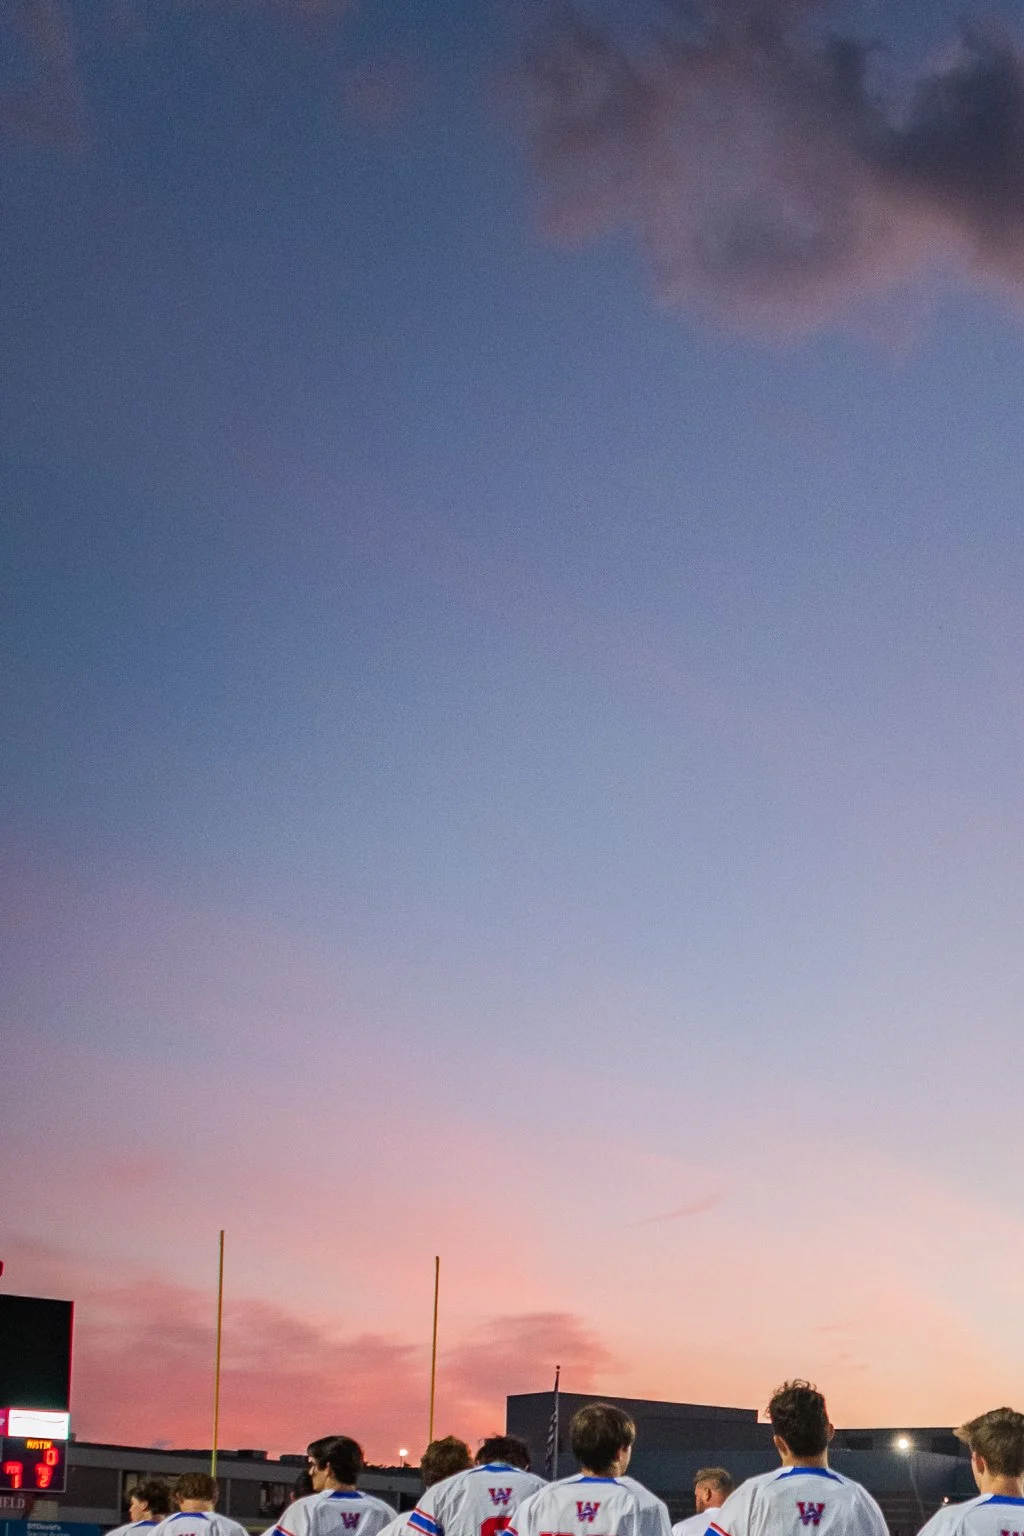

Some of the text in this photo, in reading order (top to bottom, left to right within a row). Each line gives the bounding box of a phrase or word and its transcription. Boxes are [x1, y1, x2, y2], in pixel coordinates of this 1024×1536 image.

[26, 1440, 53, 1450] AUSTIN
[46, 1449, 58, 1466] 0
[488, 1488, 513, 1505] W
[576, 1501, 601, 1523] W
[797, 1502, 825, 1526] W
